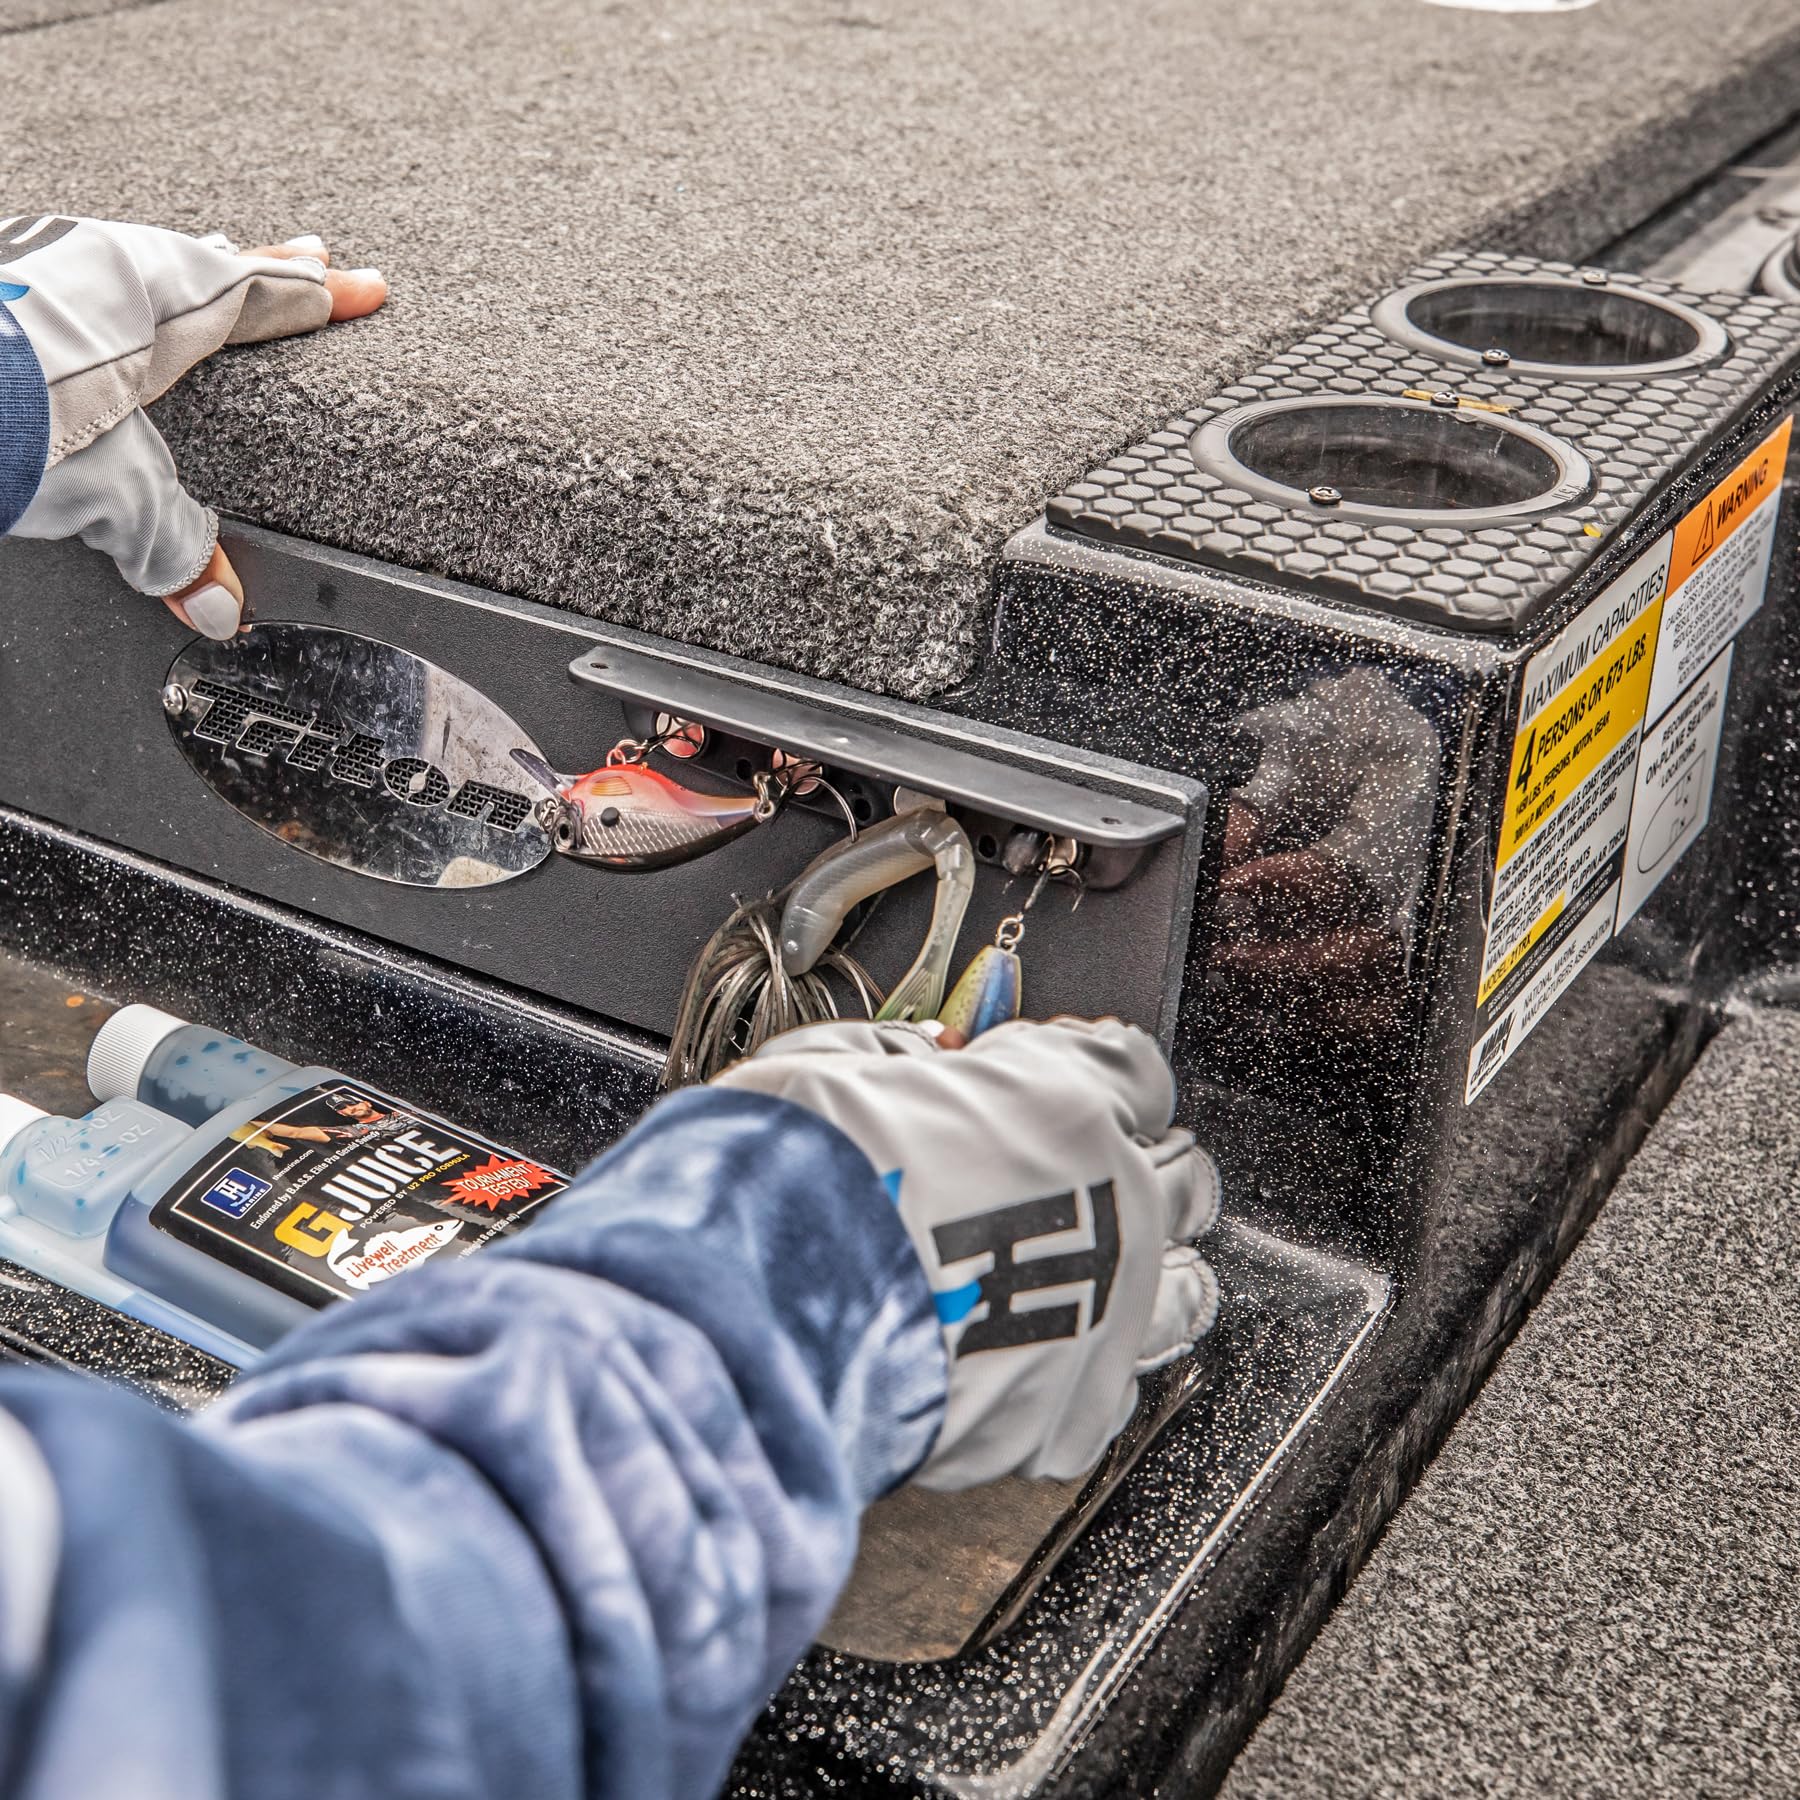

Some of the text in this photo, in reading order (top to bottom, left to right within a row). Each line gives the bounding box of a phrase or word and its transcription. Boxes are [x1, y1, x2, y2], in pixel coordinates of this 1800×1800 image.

[1716, 457, 1769, 529] WARNING
[1521, 640, 1589, 724] MAXIMUM
[1592, 563, 1666, 656] CAPACITIES
[1514, 726, 1537, 795] 4
[1535, 693, 1587, 762] PERSONS
[1586, 675, 1604, 711] OR
[1604, 655, 1625, 693] 675
[1625, 630, 1649, 672] LBS.
[1527, 817, 1557, 856] COMPLIES
[1556, 801, 1570, 826] WITH
[1581, 769, 1600, 799] COAST
[1599, 749, 1619, 779] GUARD
[1618, 728, 1638, 760] SAFETY
[1534, 789, 1556, 821] MOTOR
[1493, 863, 1529, 911] STANDARDS
[1535, 832, 1557, 866] EFFECT
[1556, 822, 1566, 842] ON
[1565, 810, 1577, 832] THE
[1576, 794, 1592, 821] DATE
[1599, 747, 1636, 795] CERTIFICATION
[1490, 900, 1514, 934] MEETS
[1527, 867, 1542, 894] EPA
[1542, 848, 1560, 877] EVAP
[1560, 807, 1598, 857] STANDARDS
[1597, 785, 1618, 816] USING
[1543, 870, 1568, 906] TRITON
[1568, 844, 1591, 878] BOATS
[1487, 857, 1568, 954] CERTIFIED COMPONENTS
[1520, 913, 1612, 1029] MANUFACTURERS ASSOCIATION
[1523, 939, 1577, 1010] NATIONAL MARINE
[272, 1149, 315, 1181] thmarine.com
[310, 1160, 329, 1175] Elite
[324, 1153, 340, 1166] Pro
[336, 1140, 360, 1157] Gerald
[281, 1187, 292, 1204] by
[286, 1172, 315, 1195] B.A.S.S.
[360, 1153, 471, 1229] POWERED BY U2 PRO FORMULA
[456, 1164, 533, 1192] TOURNAMENT
[481, 1176, 533, 1198] TESTED!
[239, 1188, 266, 1213] MARINE
[250, 1197, 283, 1230] Endorsed
[486, 1229, 497, 1237] oz
[347, 1239, 398, 1279] Livewell
[378, 1232, 443, 1276] Treatment
